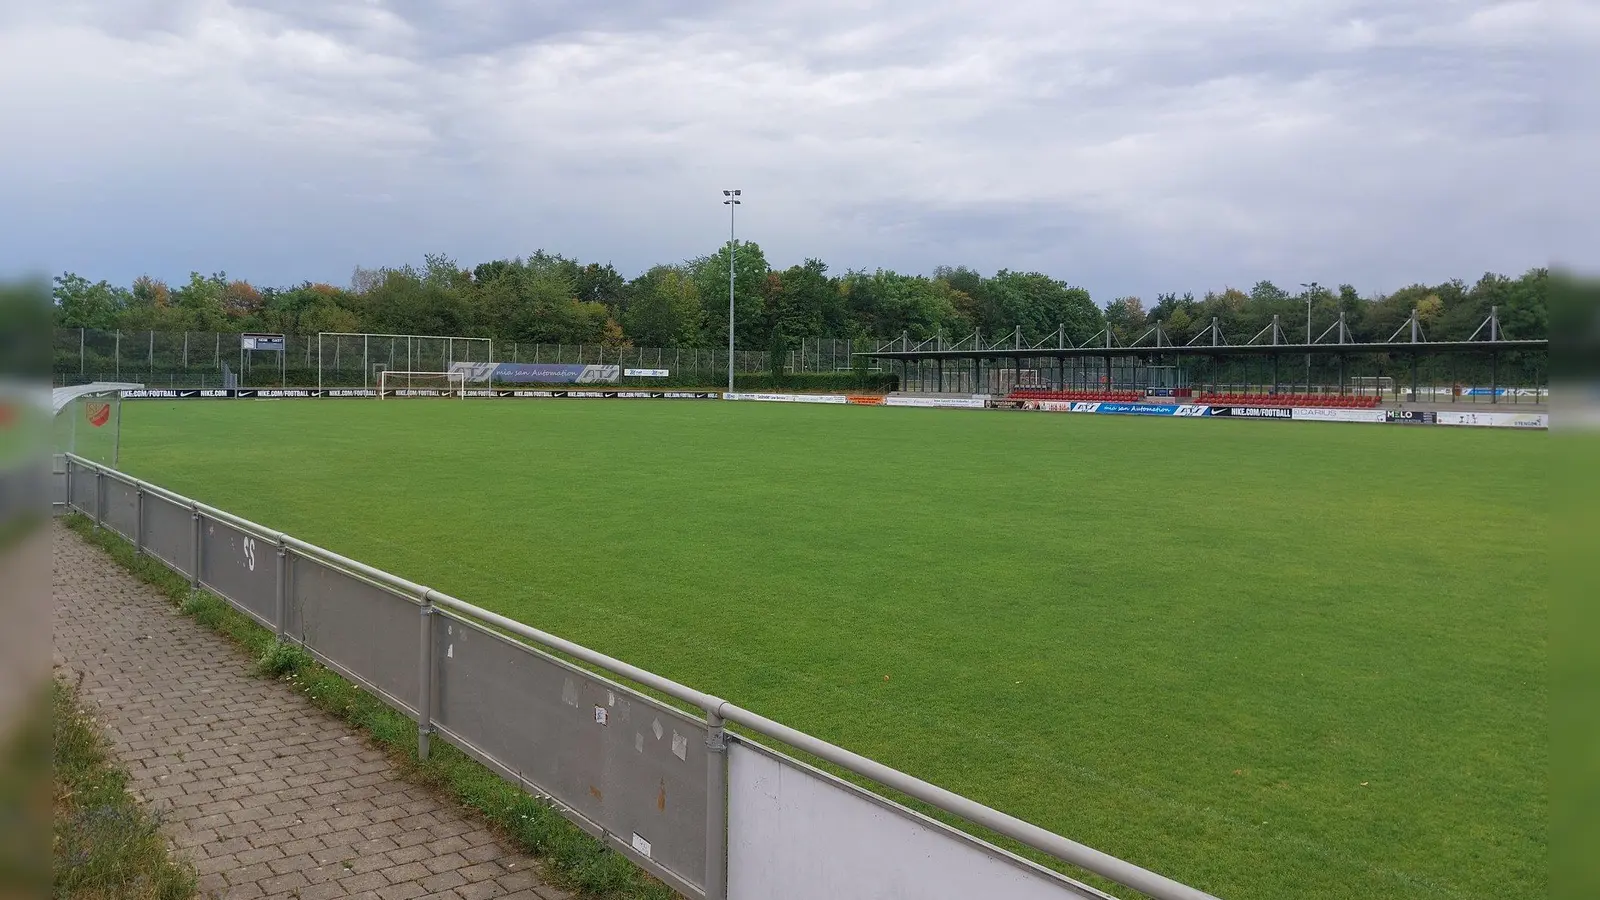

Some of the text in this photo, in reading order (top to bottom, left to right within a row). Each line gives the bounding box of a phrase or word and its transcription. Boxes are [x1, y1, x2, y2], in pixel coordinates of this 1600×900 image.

[531, 369, 578, 377] Automation
[582, 370, 618, 378] ATS
[1231, 408, 1291, 418] NIKE.COM/FOOTBALL
